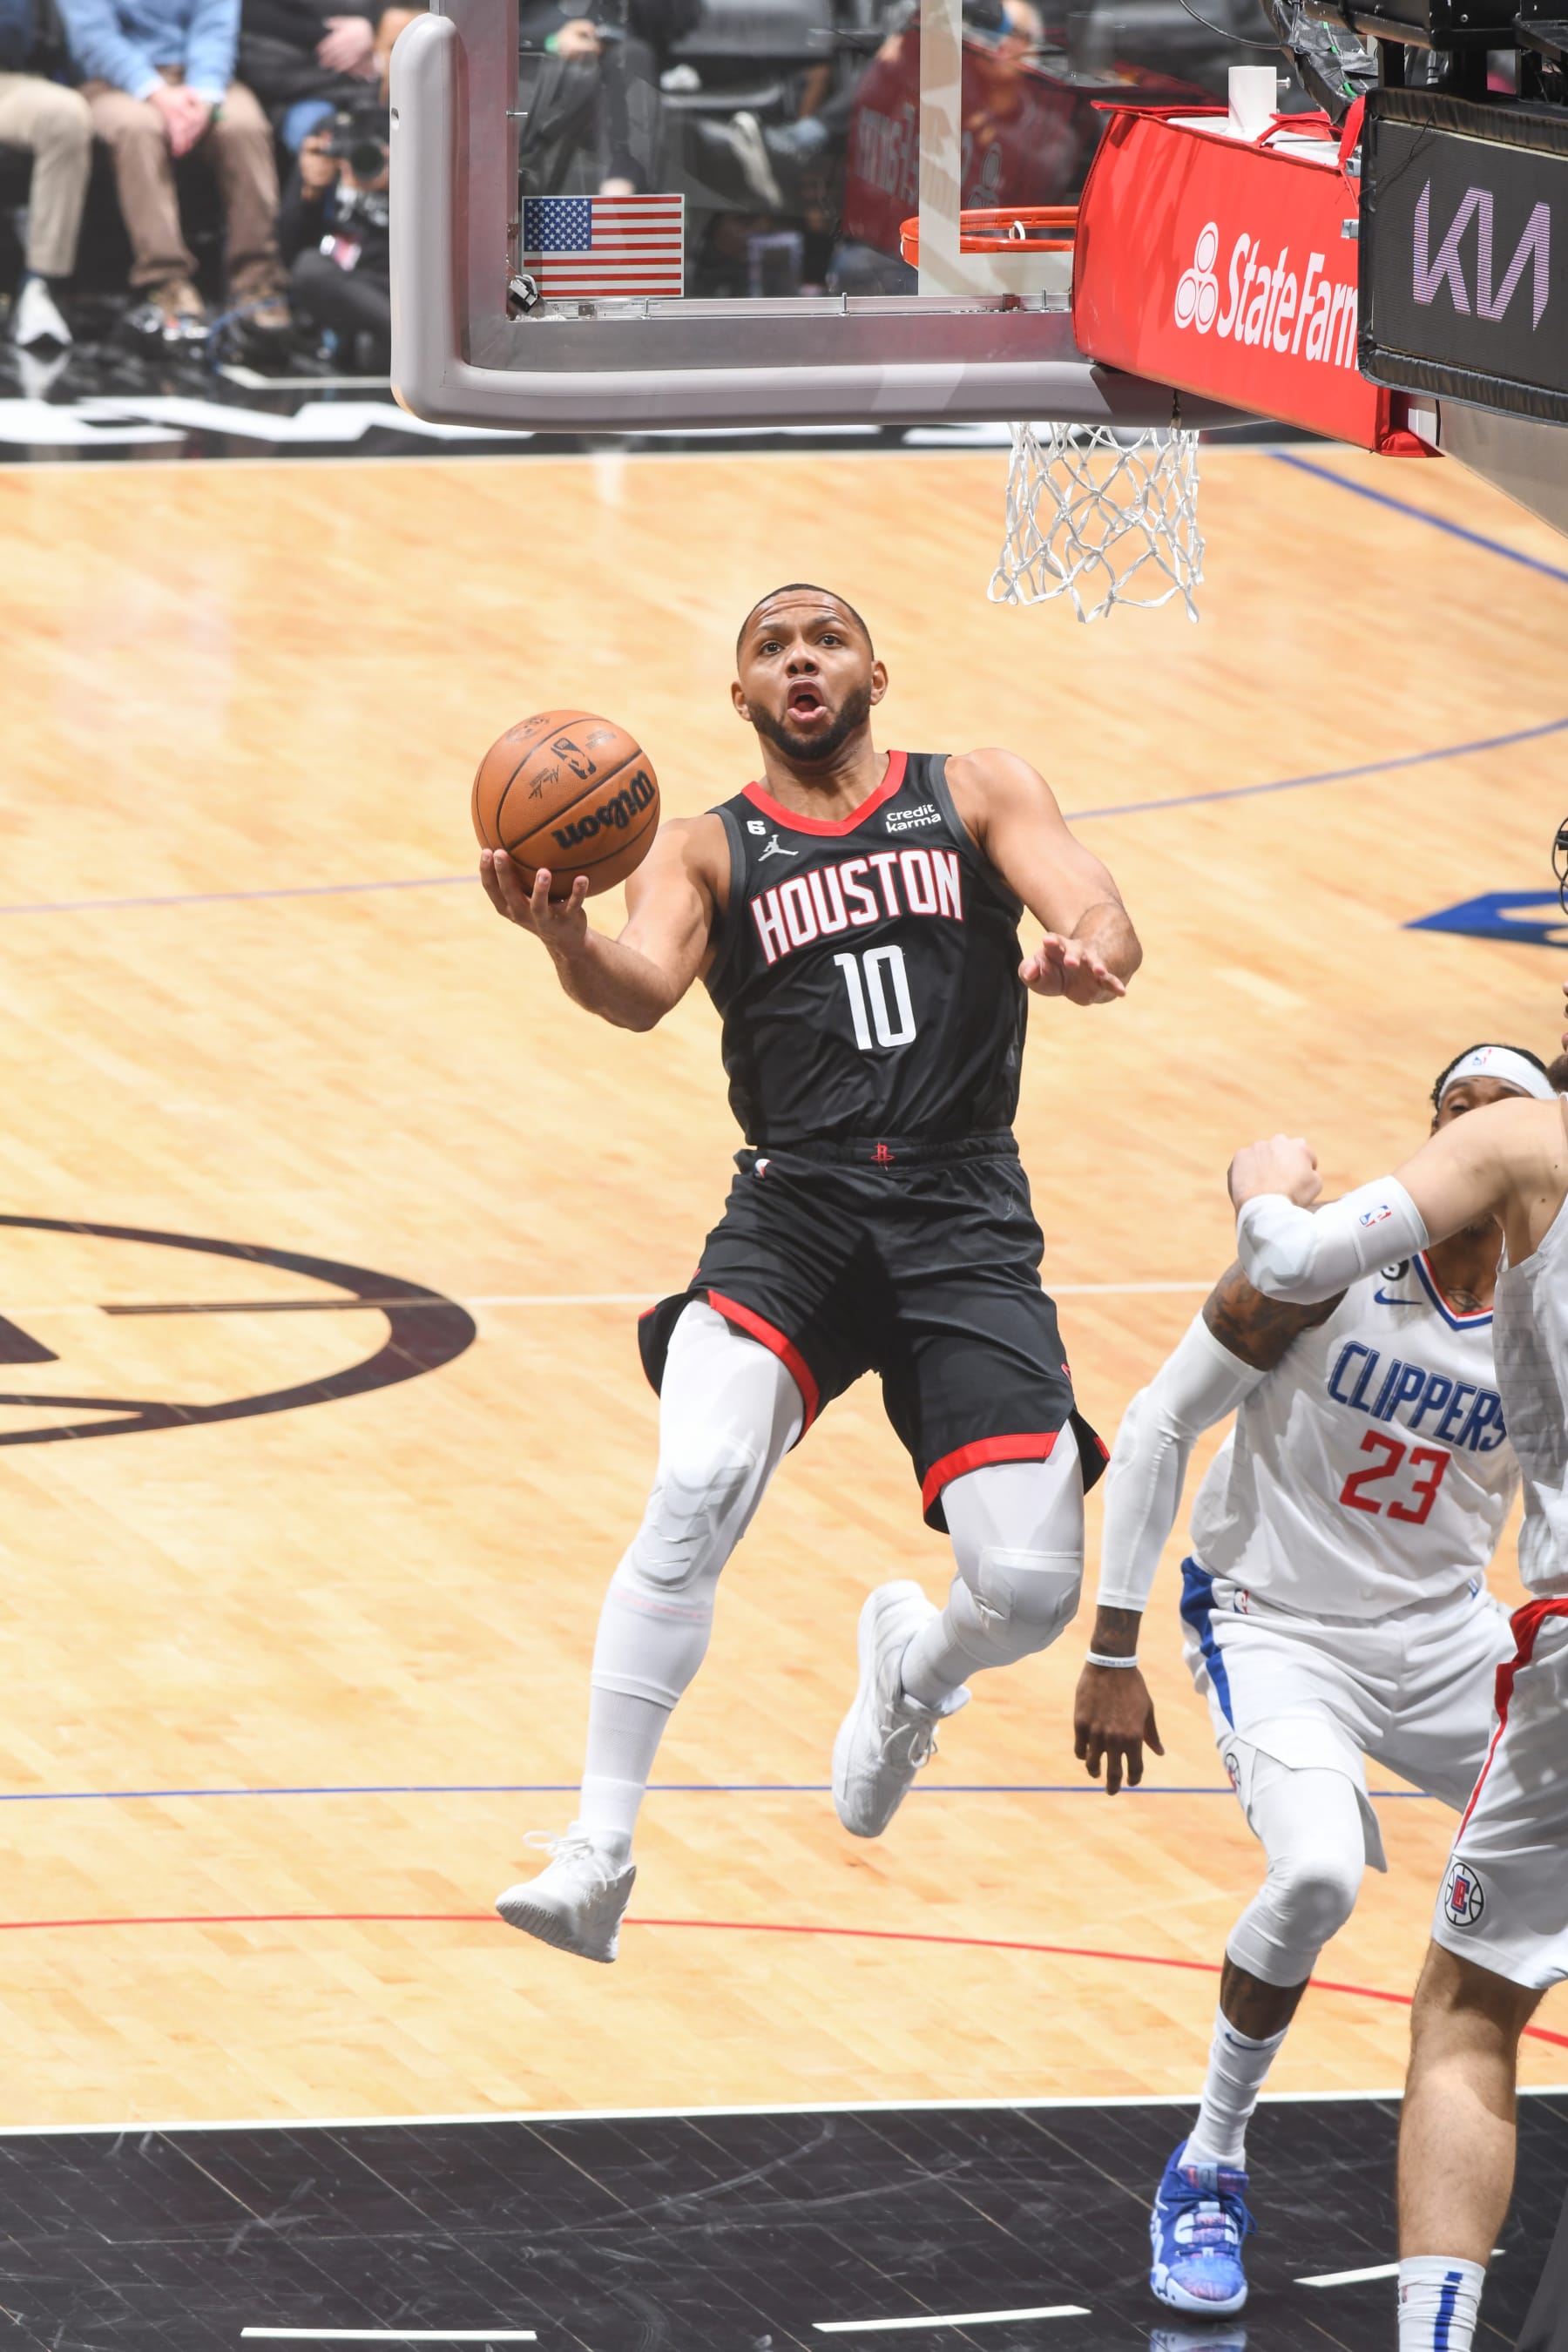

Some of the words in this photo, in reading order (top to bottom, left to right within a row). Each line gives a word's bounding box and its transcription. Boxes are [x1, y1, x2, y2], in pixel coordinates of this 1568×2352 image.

[551, 770, 656, 849] Wilson
[747, 821, 767, 835] 6
[885, 814, 942, 833] karma
[750, 848, 963, 965] HOUSTON
[834, 945, 916, 1051] 10
[1339, 1429, 1451, 1524] 23
